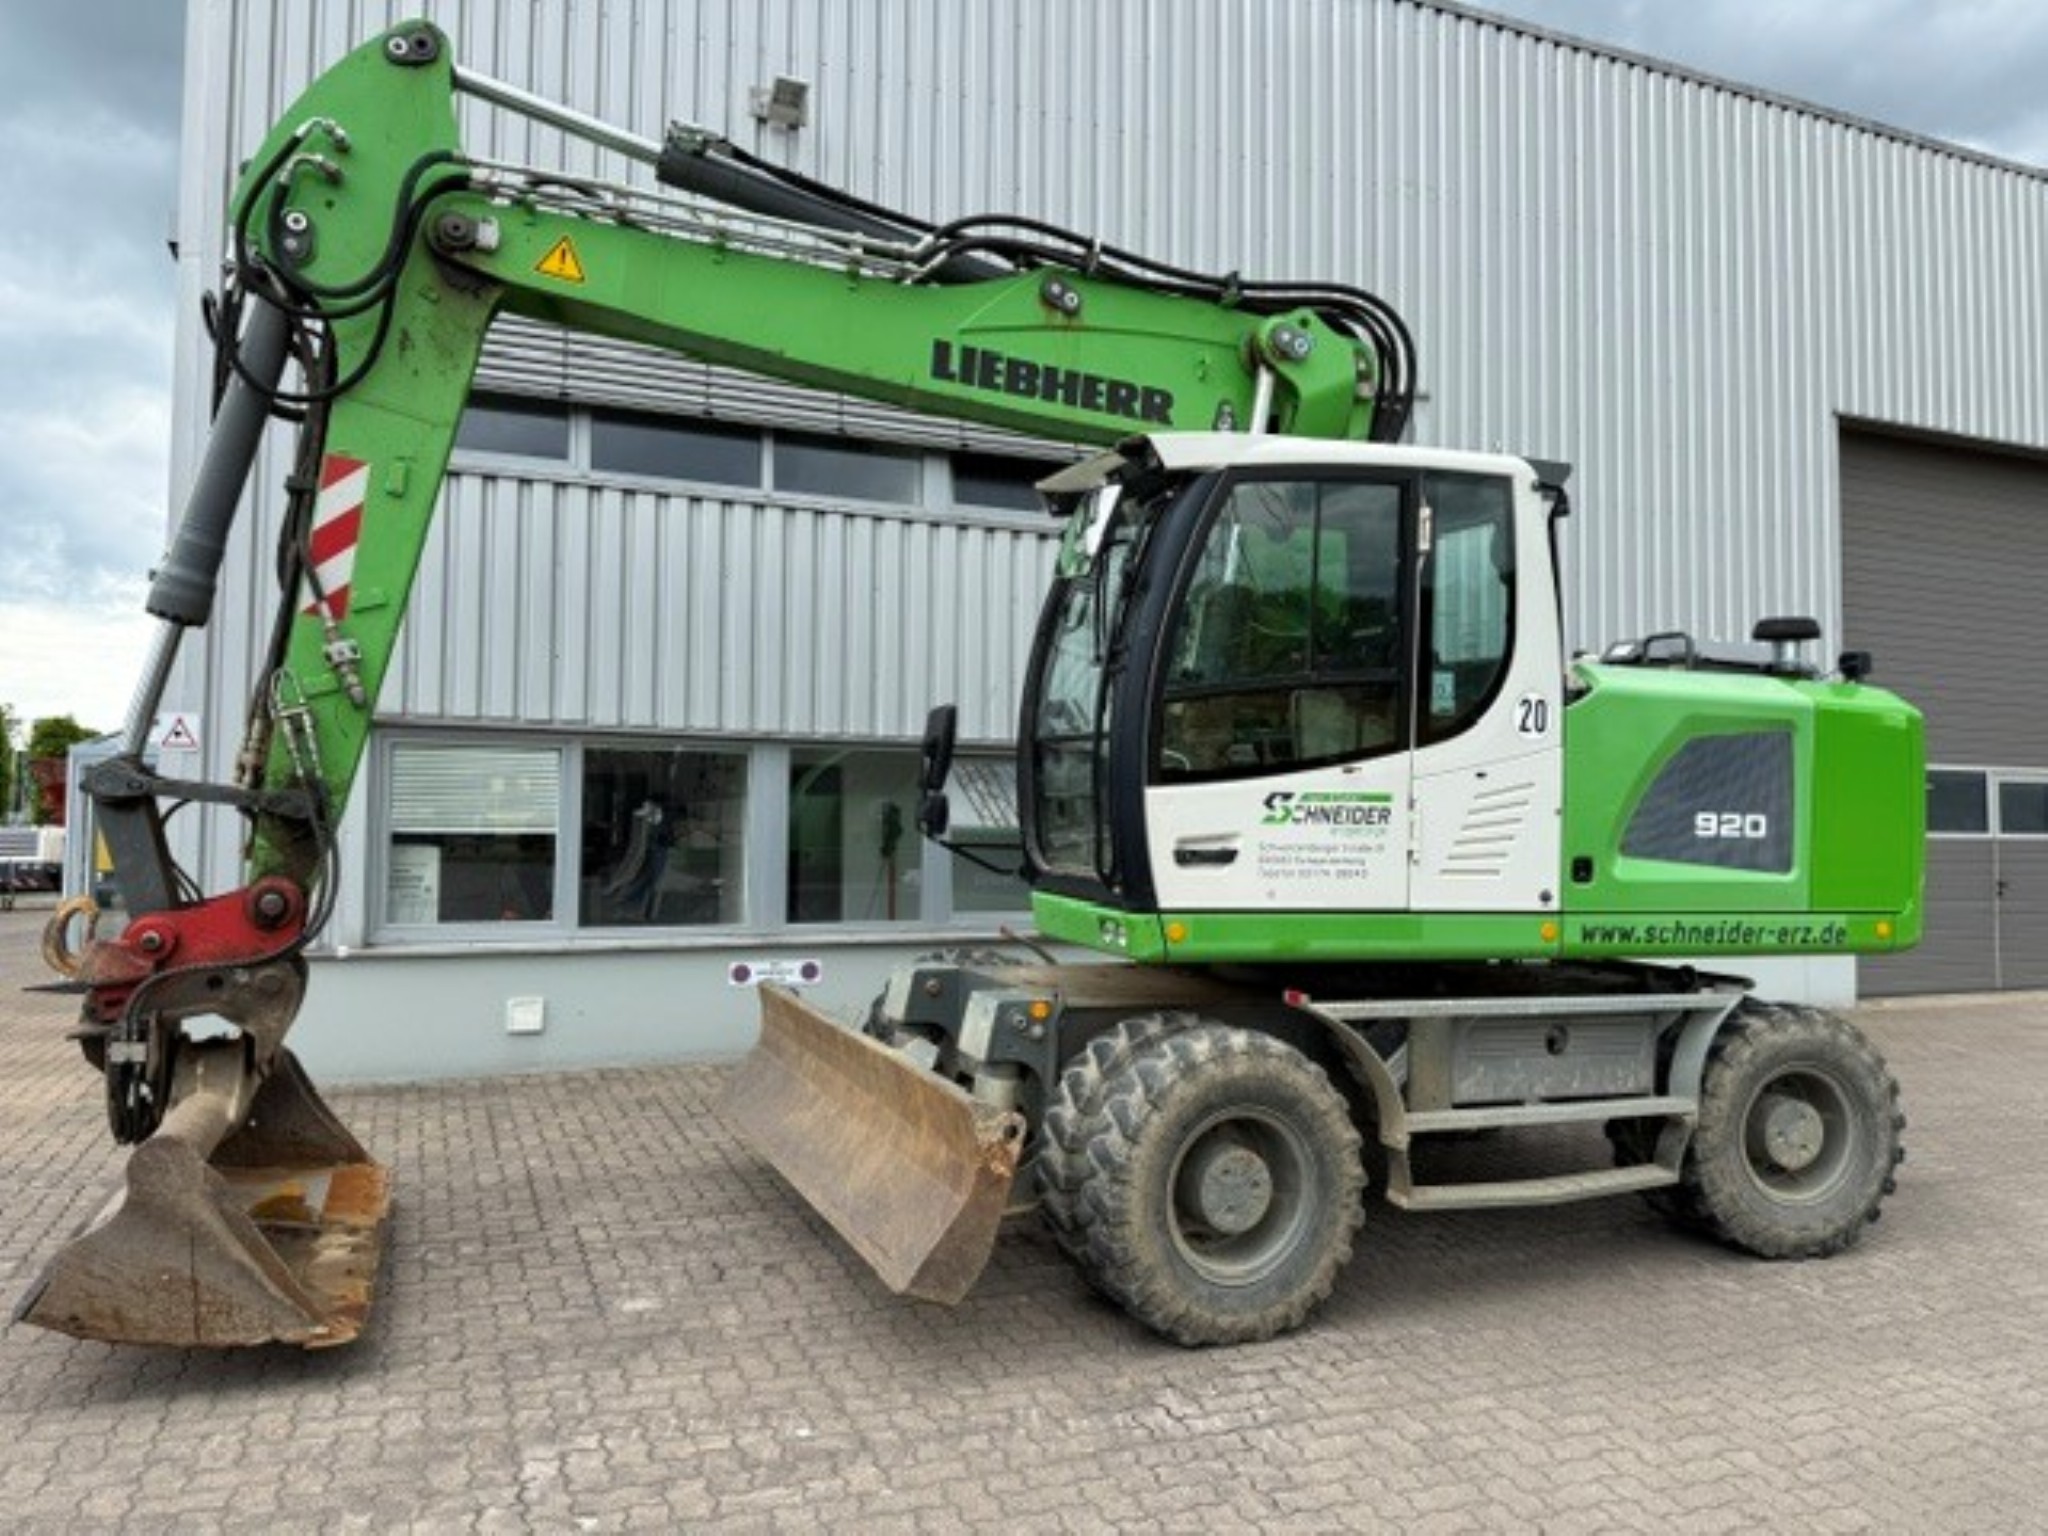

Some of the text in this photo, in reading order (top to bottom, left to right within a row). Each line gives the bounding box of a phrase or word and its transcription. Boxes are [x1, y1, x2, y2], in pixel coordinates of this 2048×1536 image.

[931, 338, 1175, 425] LIEBHERR
[1519, 699, 1548, 733] 20
[1261, 792, 1392, 825] SCHNEIDER
[1694, 811, 1767, 838] 920
[1581, 920, 1847, 944] www.schneider-erz.de
